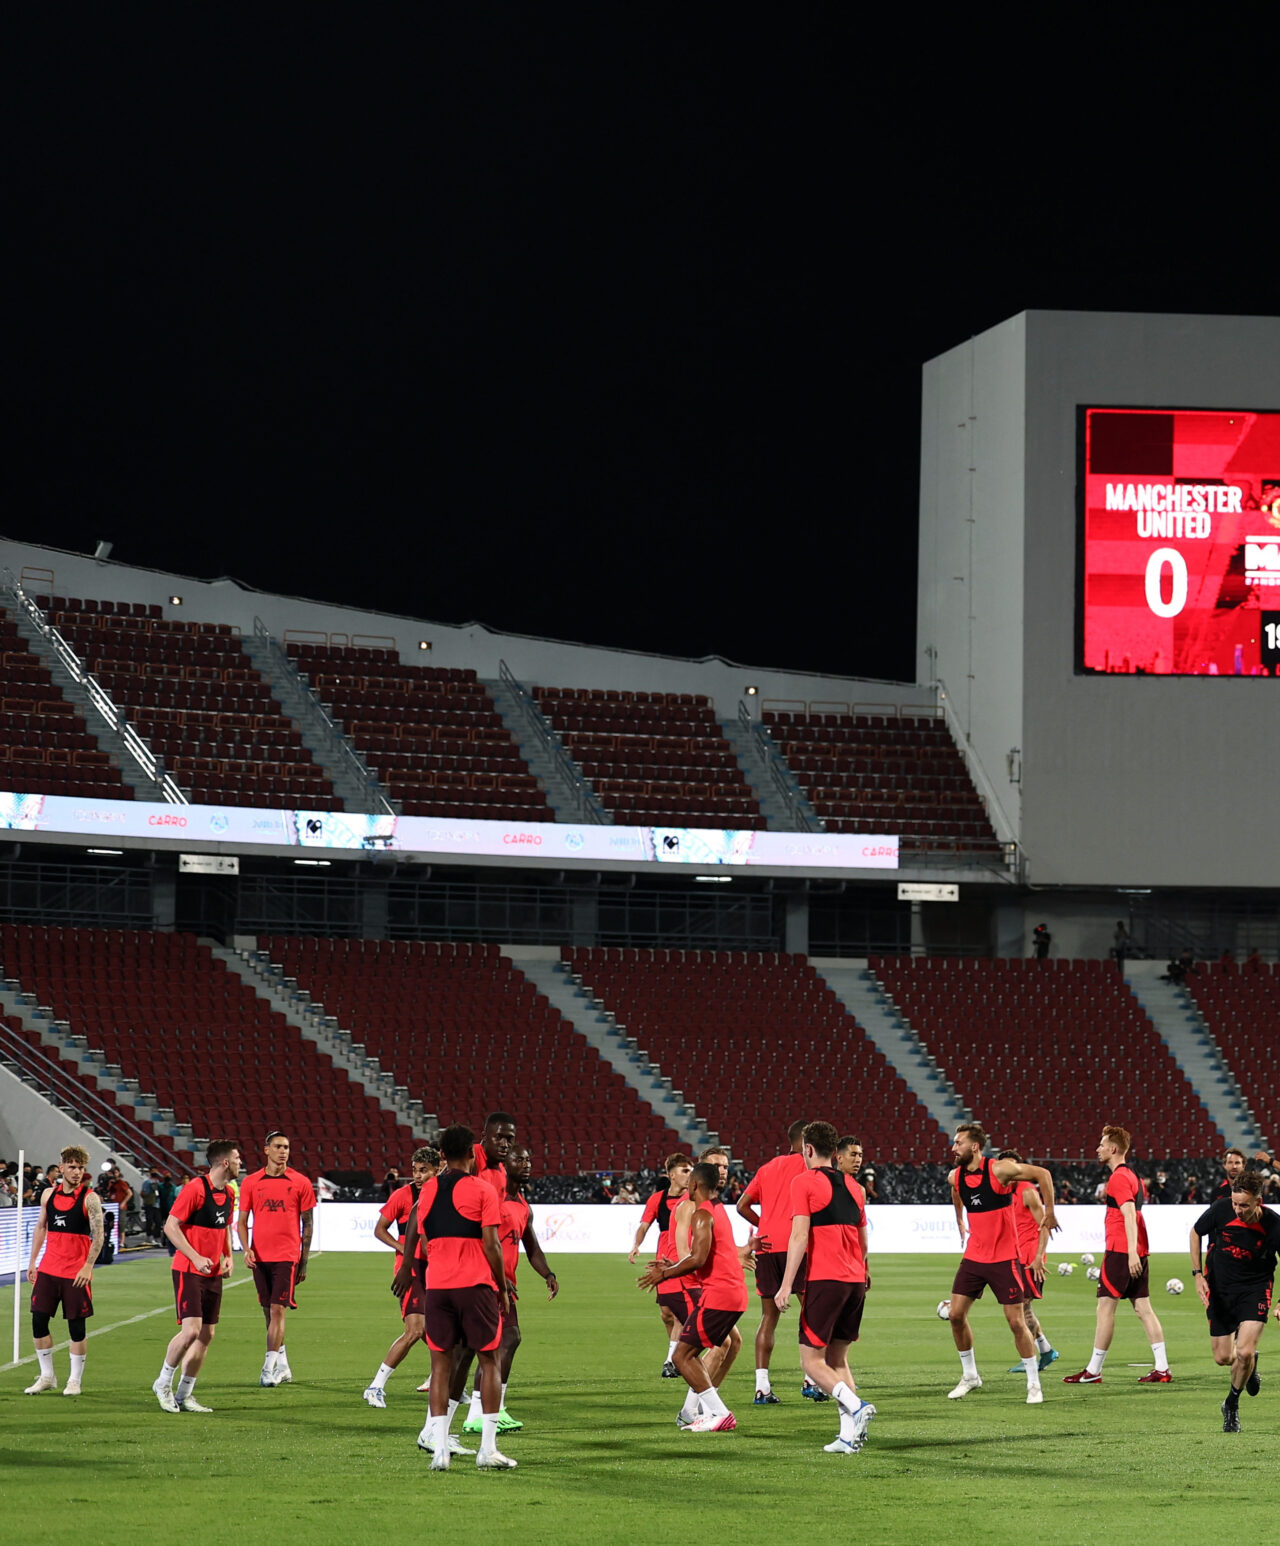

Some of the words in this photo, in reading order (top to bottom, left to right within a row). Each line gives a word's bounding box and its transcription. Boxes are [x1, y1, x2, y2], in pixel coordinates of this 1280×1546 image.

[1105, 483, 1243, 513] MANCHESTER
[1136, 510, 1212, 538] UNITED
[1144, 547, 1188, 618] 0
[148, 814, 188, 828] CARRO
[503, 832, 543, 846] CARRO
